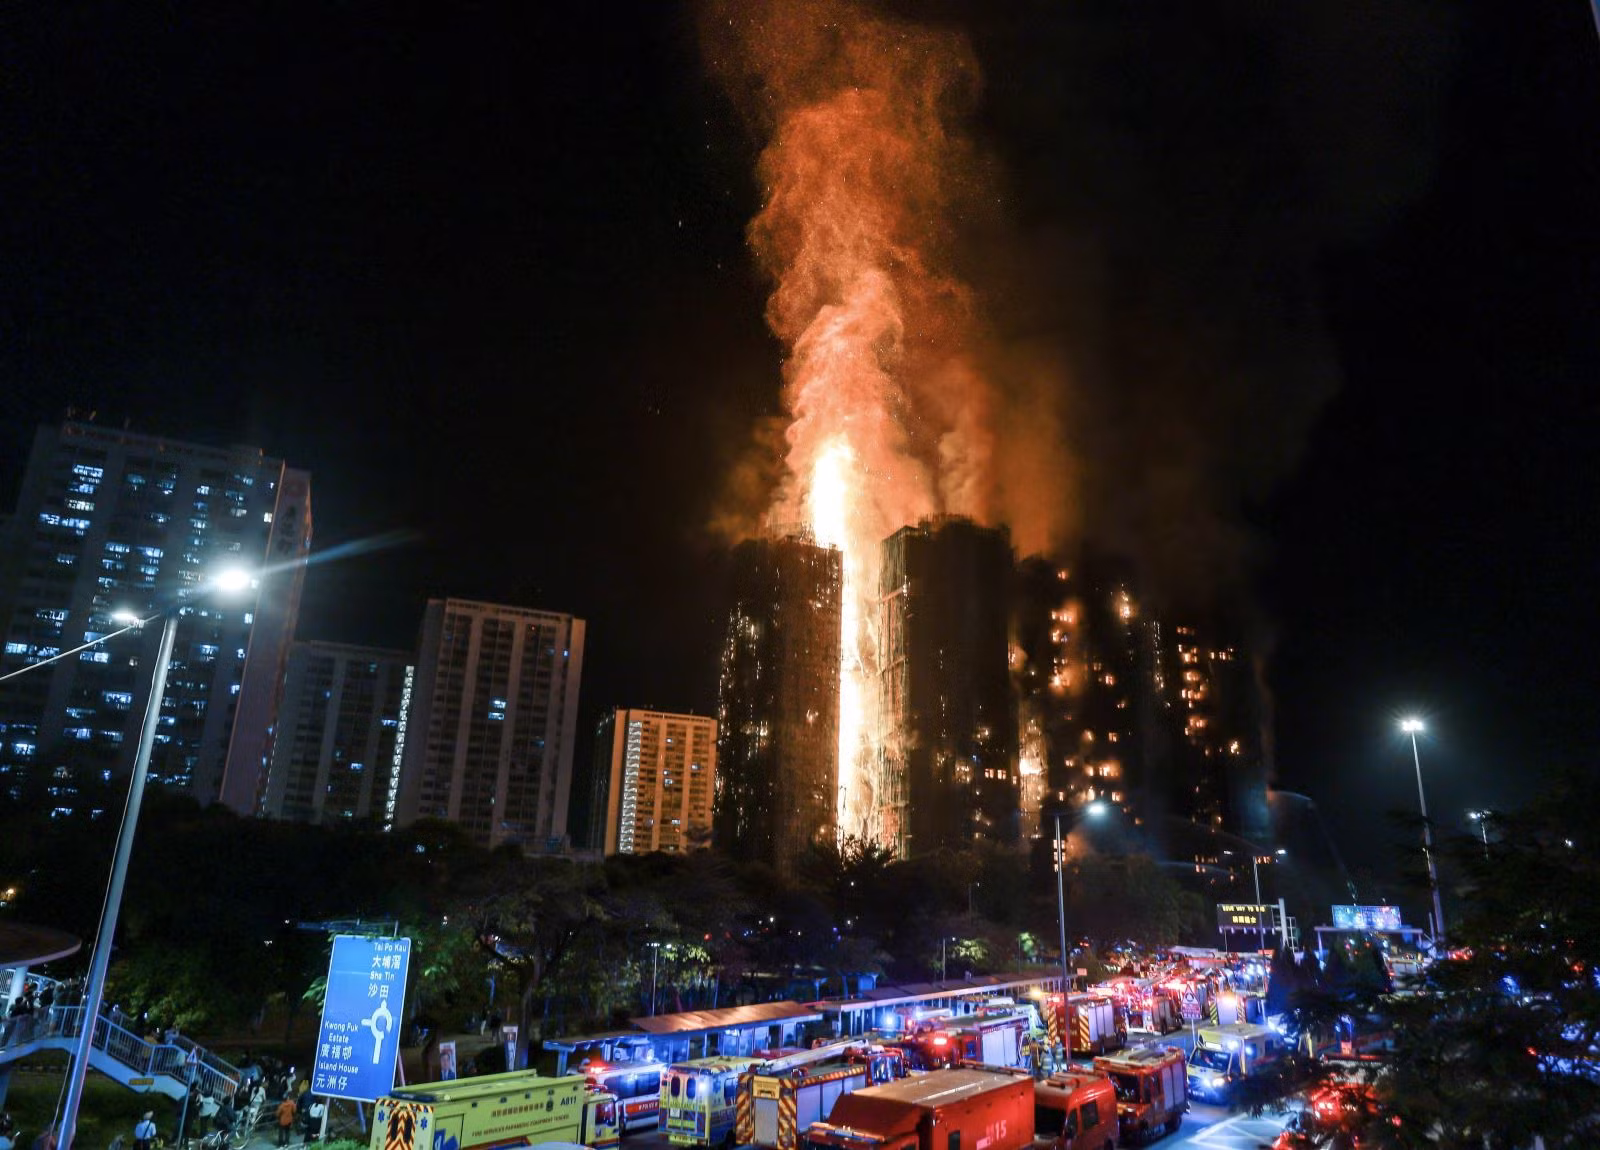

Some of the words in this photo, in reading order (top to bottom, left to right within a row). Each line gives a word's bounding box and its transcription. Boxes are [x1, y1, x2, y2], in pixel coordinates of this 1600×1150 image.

[385, 942, 393, 951] Po
[394, 943, 407, 953] Kau
[372, 954, 402, 970] 大埔滘
[370, 970, 382, 980] Sha
[385, 971, 395, 982] Tin
[368, 983, 389, 998] 沙田
[325, 1020, 346, 1032] Kwong
[347, 1022, 359, 1032] Fuk
[328, 1033, 349, 1043] Estate
[320, 1043, 353, 1061] 廣福邨
[319, 1061, 337, 1072] Island
[338, 1063, 359, 1075] House
[315, 1073, 348, 1091] 元洲仔
